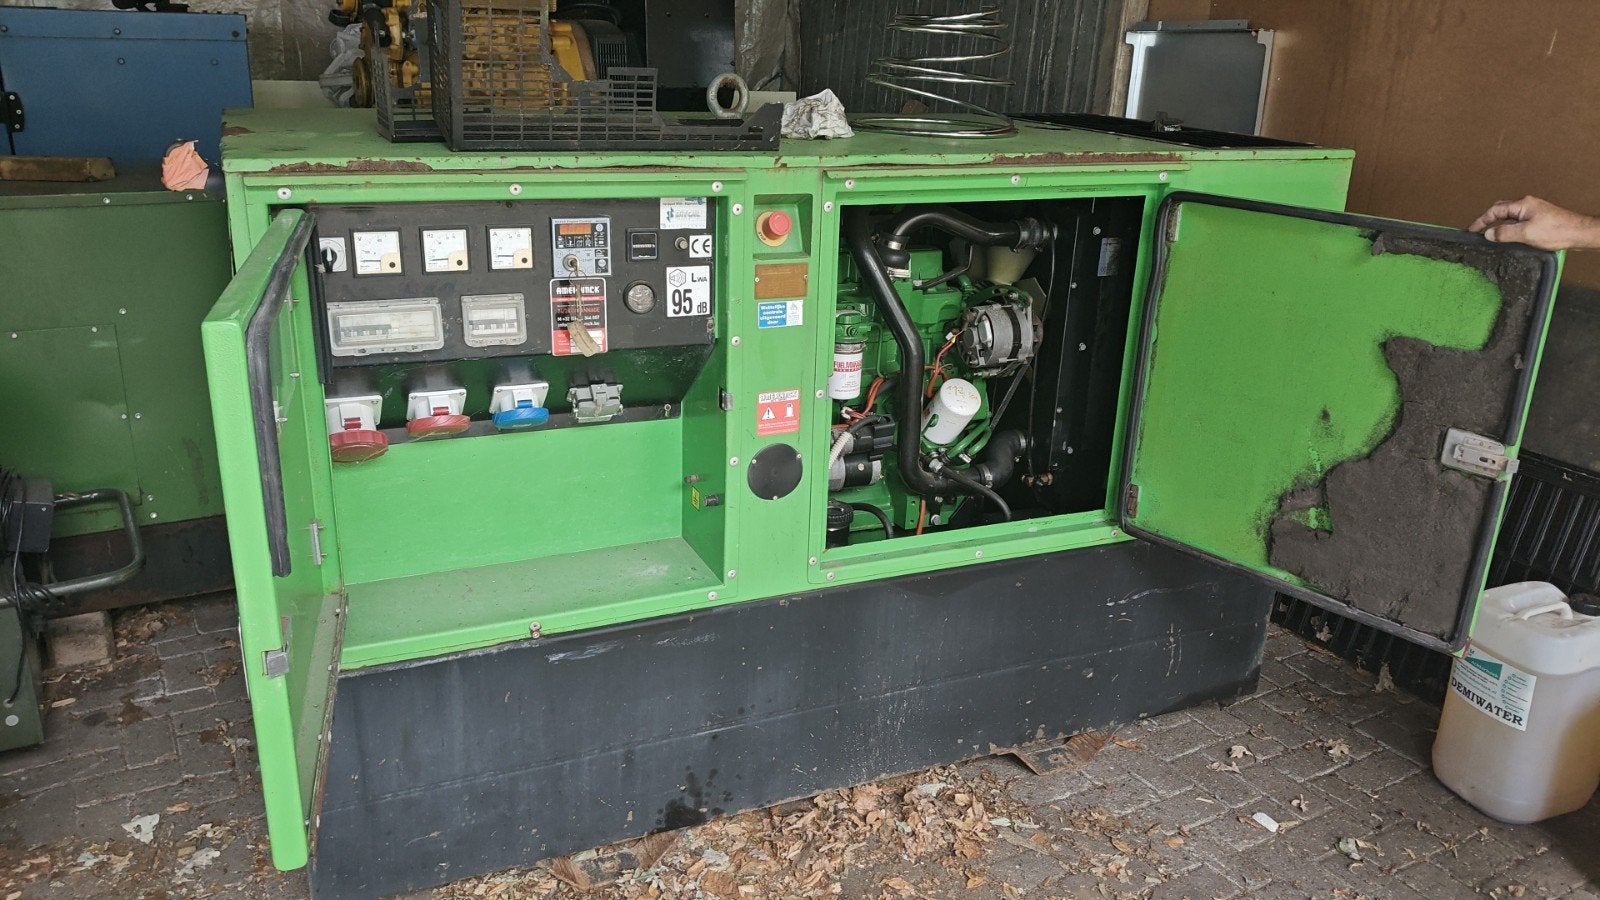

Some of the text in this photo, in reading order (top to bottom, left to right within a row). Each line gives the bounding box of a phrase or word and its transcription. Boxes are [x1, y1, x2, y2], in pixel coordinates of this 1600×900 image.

[691, 239, 710, 254] CE
[672, 289, 693, 315] 95
[697, 302, 708, 314] dB
[1451, 677, 1523, 726] DEMIWATER
